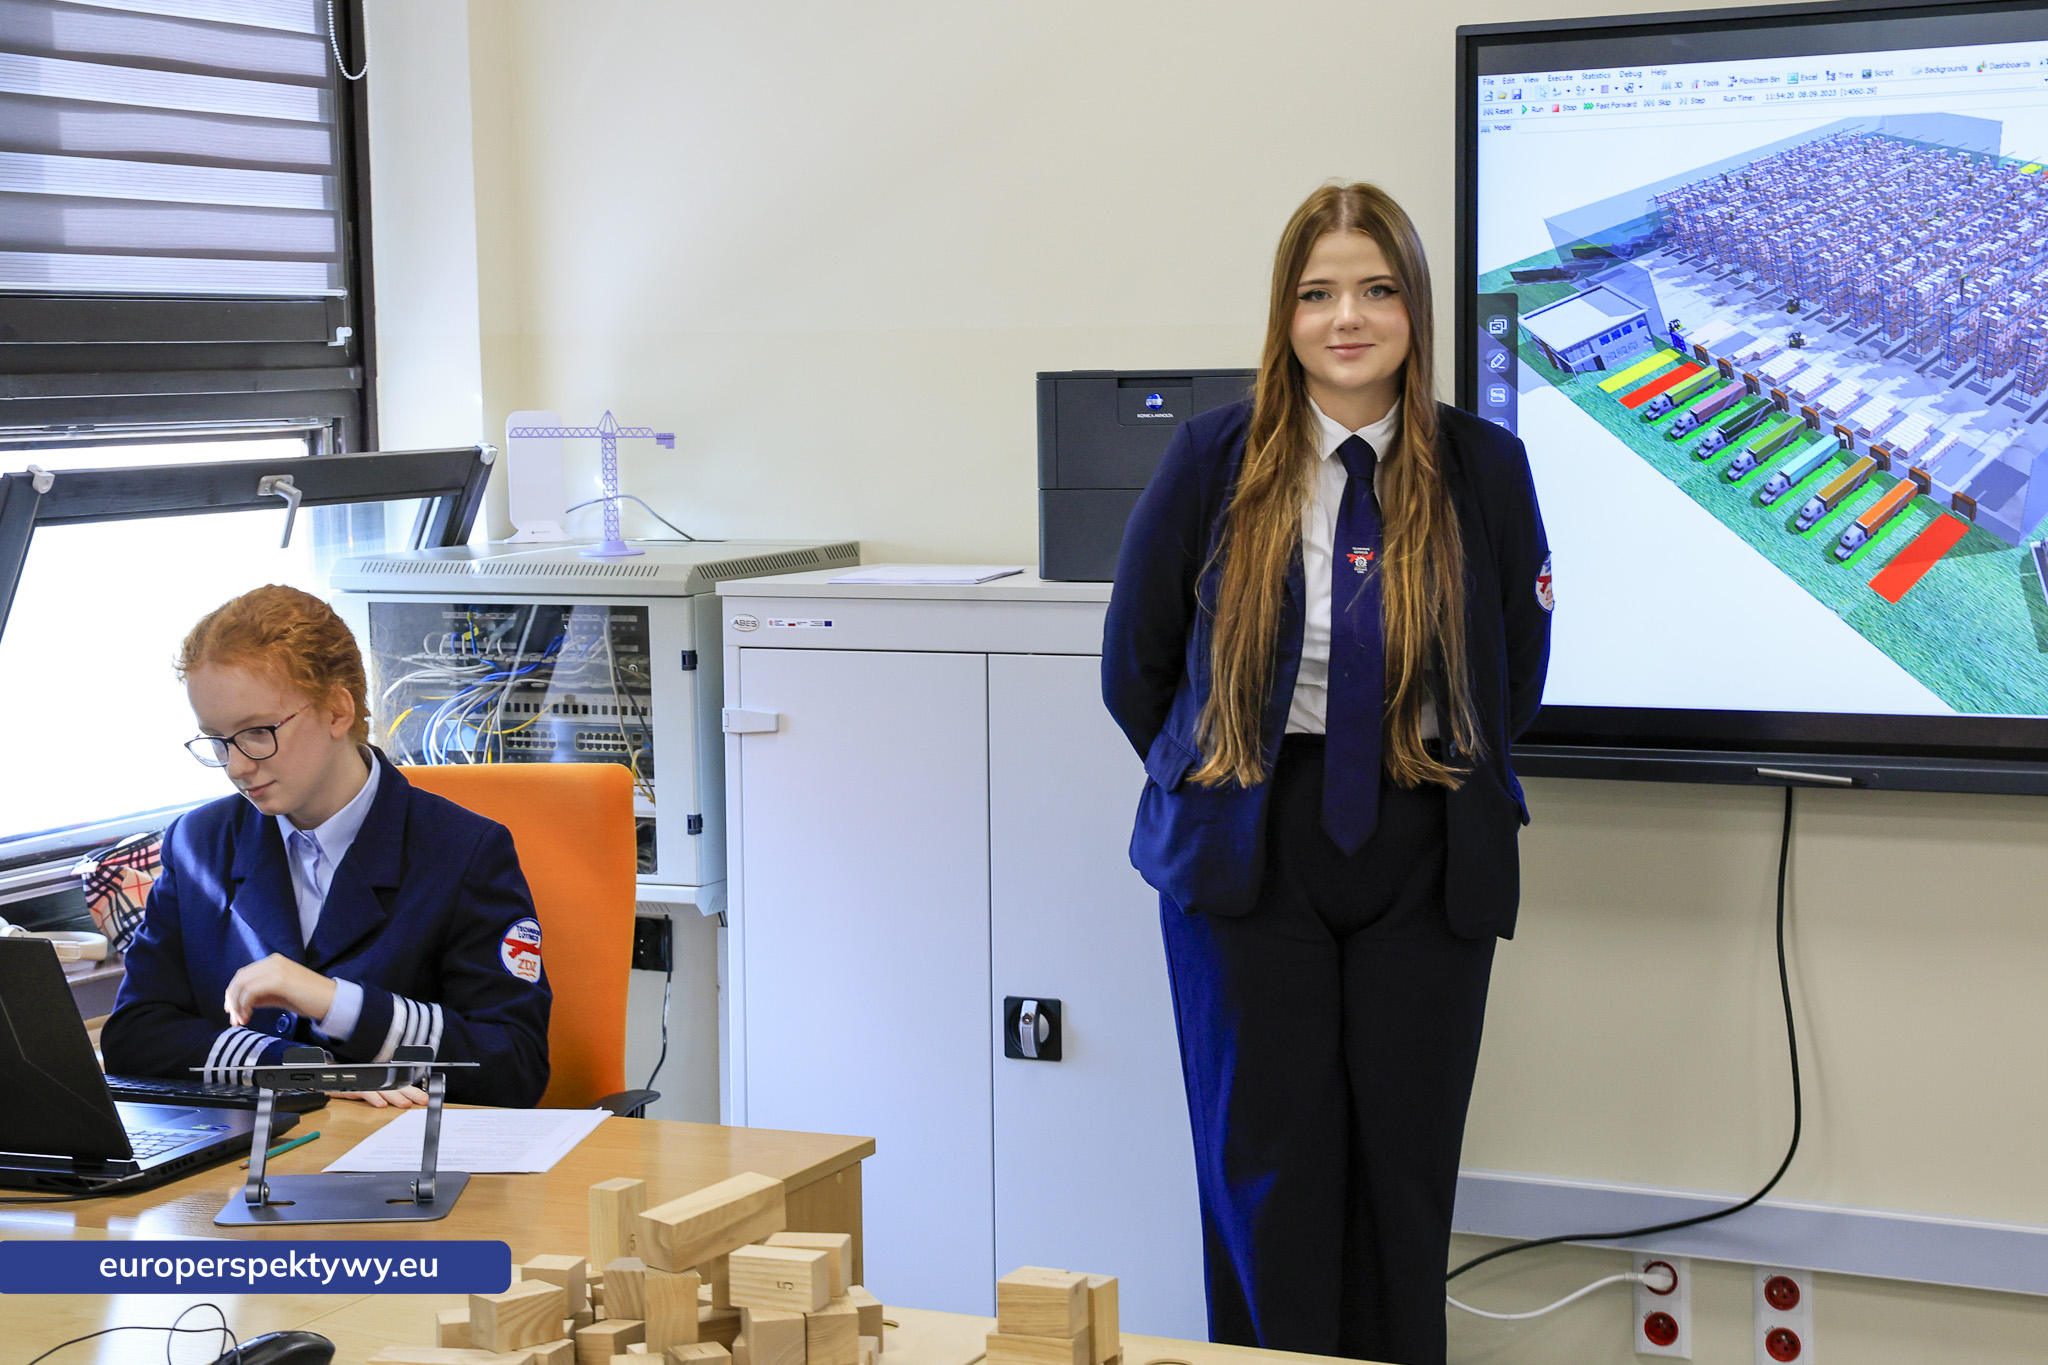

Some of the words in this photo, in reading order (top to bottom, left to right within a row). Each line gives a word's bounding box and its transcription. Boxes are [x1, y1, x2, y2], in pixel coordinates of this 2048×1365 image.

[1548, 75, 1573, 83] Execute
[1582, 72, 1611, 80] Statistics
[1619, 70, 1642, 79] Debug
[1651, 69, 1667, 77] Help
[1800, 73, 1817, 81] Excel
[1839, 71, 1853, 79] Tree
[1874, 69, 1894, 77] Script
[1925, 65, 1968, 75] Backgrounds
[1989, 61, 2031, 70] Dashboards
[1495, 107, 1513, 115] Reset
[1611, 101, 1637, 109] Forward
[1658, 99, 1671, 107] Skip
[1691, 97, 1705, 105] Step
[1494, 123, 1511, 131] Model
[733, 619, 757, 627] ABES
[517, 958, 537, 972] ZDZ
